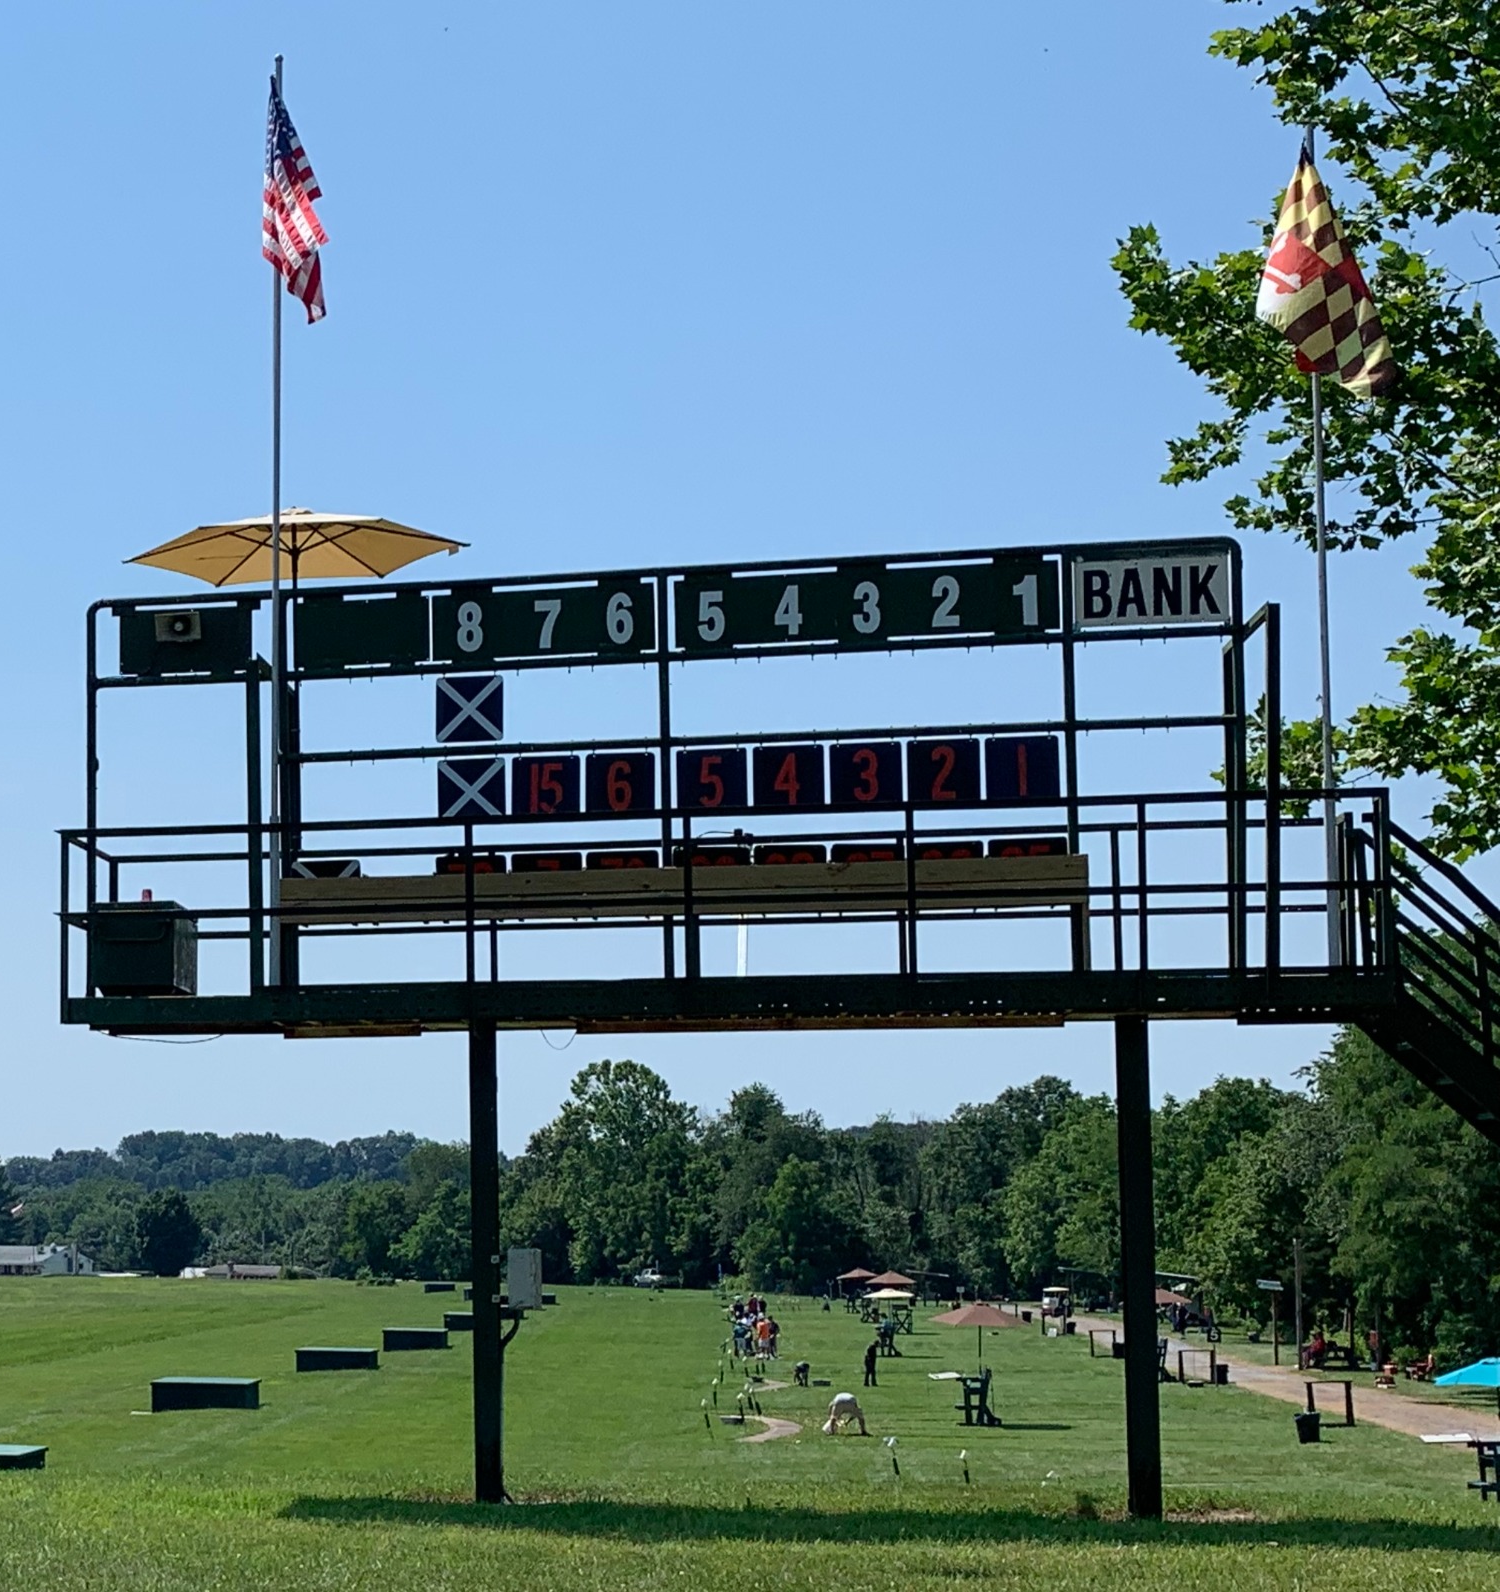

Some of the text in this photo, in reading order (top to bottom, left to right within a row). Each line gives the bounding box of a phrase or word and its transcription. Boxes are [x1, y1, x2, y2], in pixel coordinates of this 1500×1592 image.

[698, 574, 1039, 641] 5 4 3 2 1
[1083, 564, 1221, 619] BANK
[457, 593, 633, 652] 8 7 6
[530, 763, 563, 813] 15
[607, 761, 631, 811] 6
[700, 756, 724, 807] 5
[774, 752, 800, 805] 4
[853, 748, 879, 801] 3
[931, 745, 956, 800] 2
[1018, 743, 1027, 796] 1
[1210, 1329, 1219, 1340] 5
